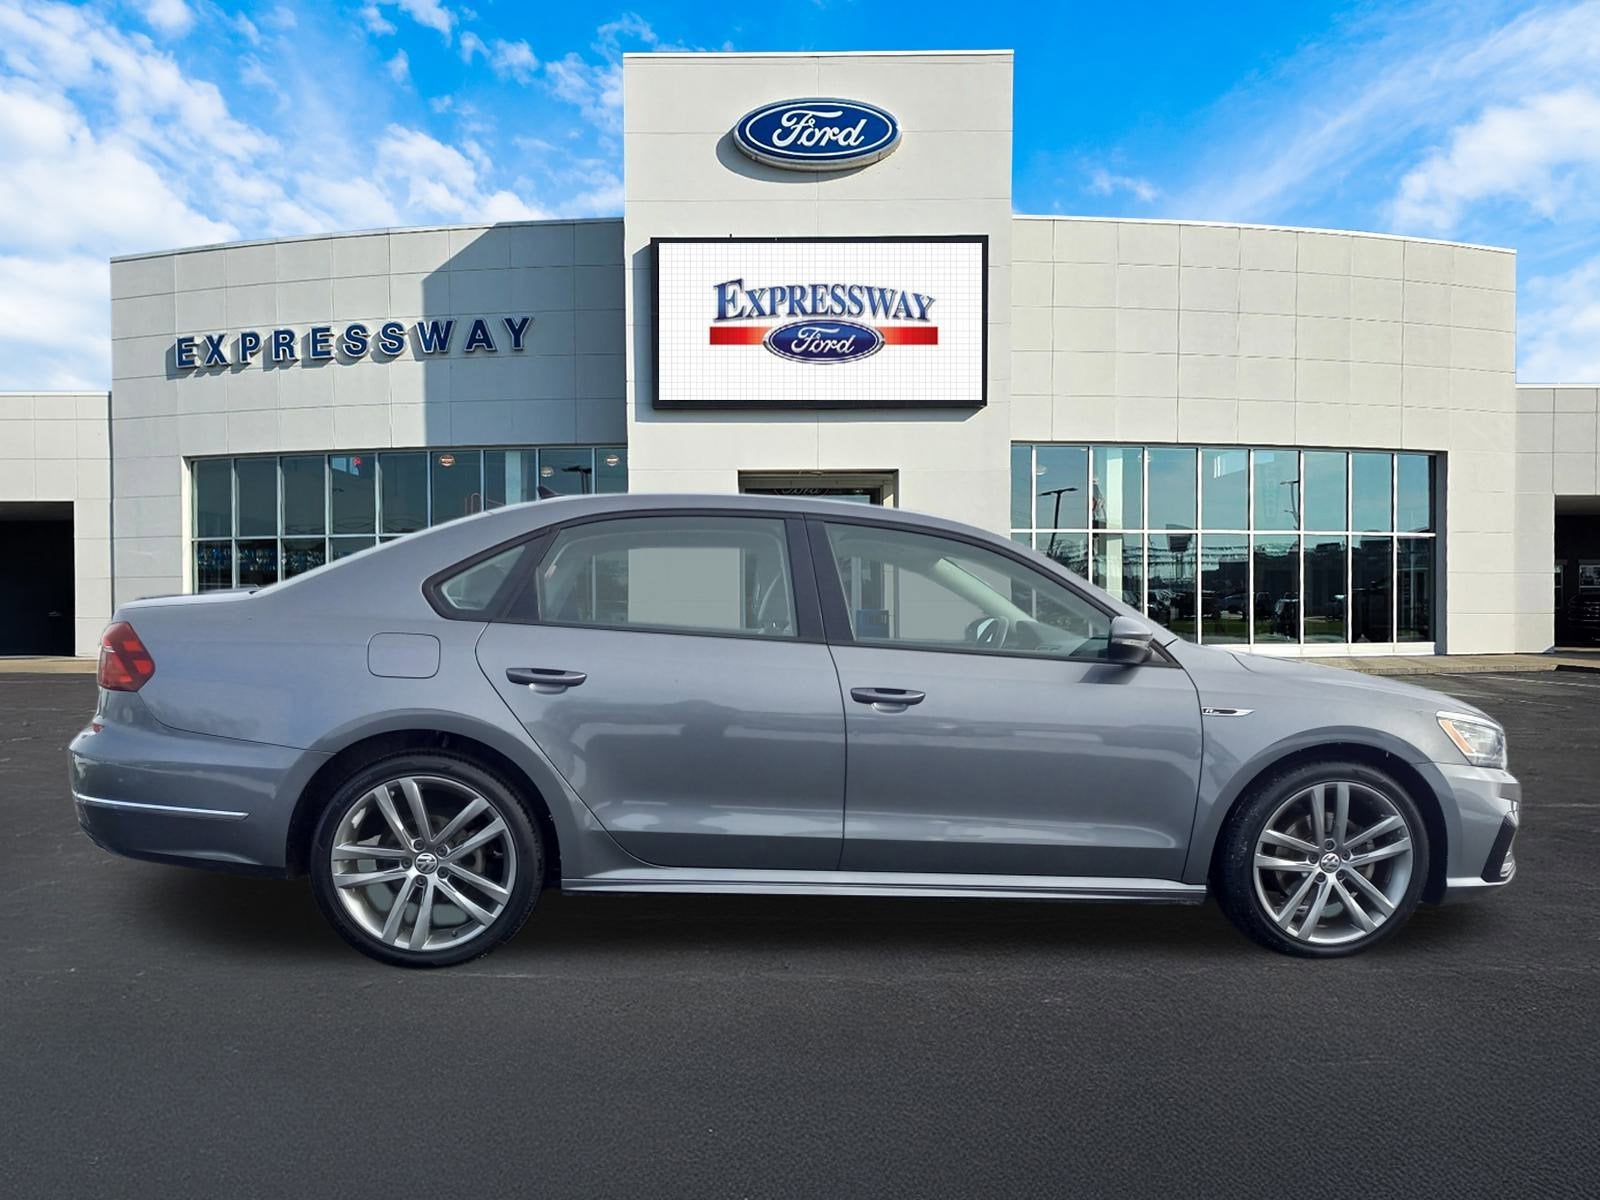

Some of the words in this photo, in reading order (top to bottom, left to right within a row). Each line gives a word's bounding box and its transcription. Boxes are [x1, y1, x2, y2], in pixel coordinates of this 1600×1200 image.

[772, 109, 867, 147] Ford
[175, 316, 532, 369] EXPRESSWAY
[791, 326, 855, 354] Ford
